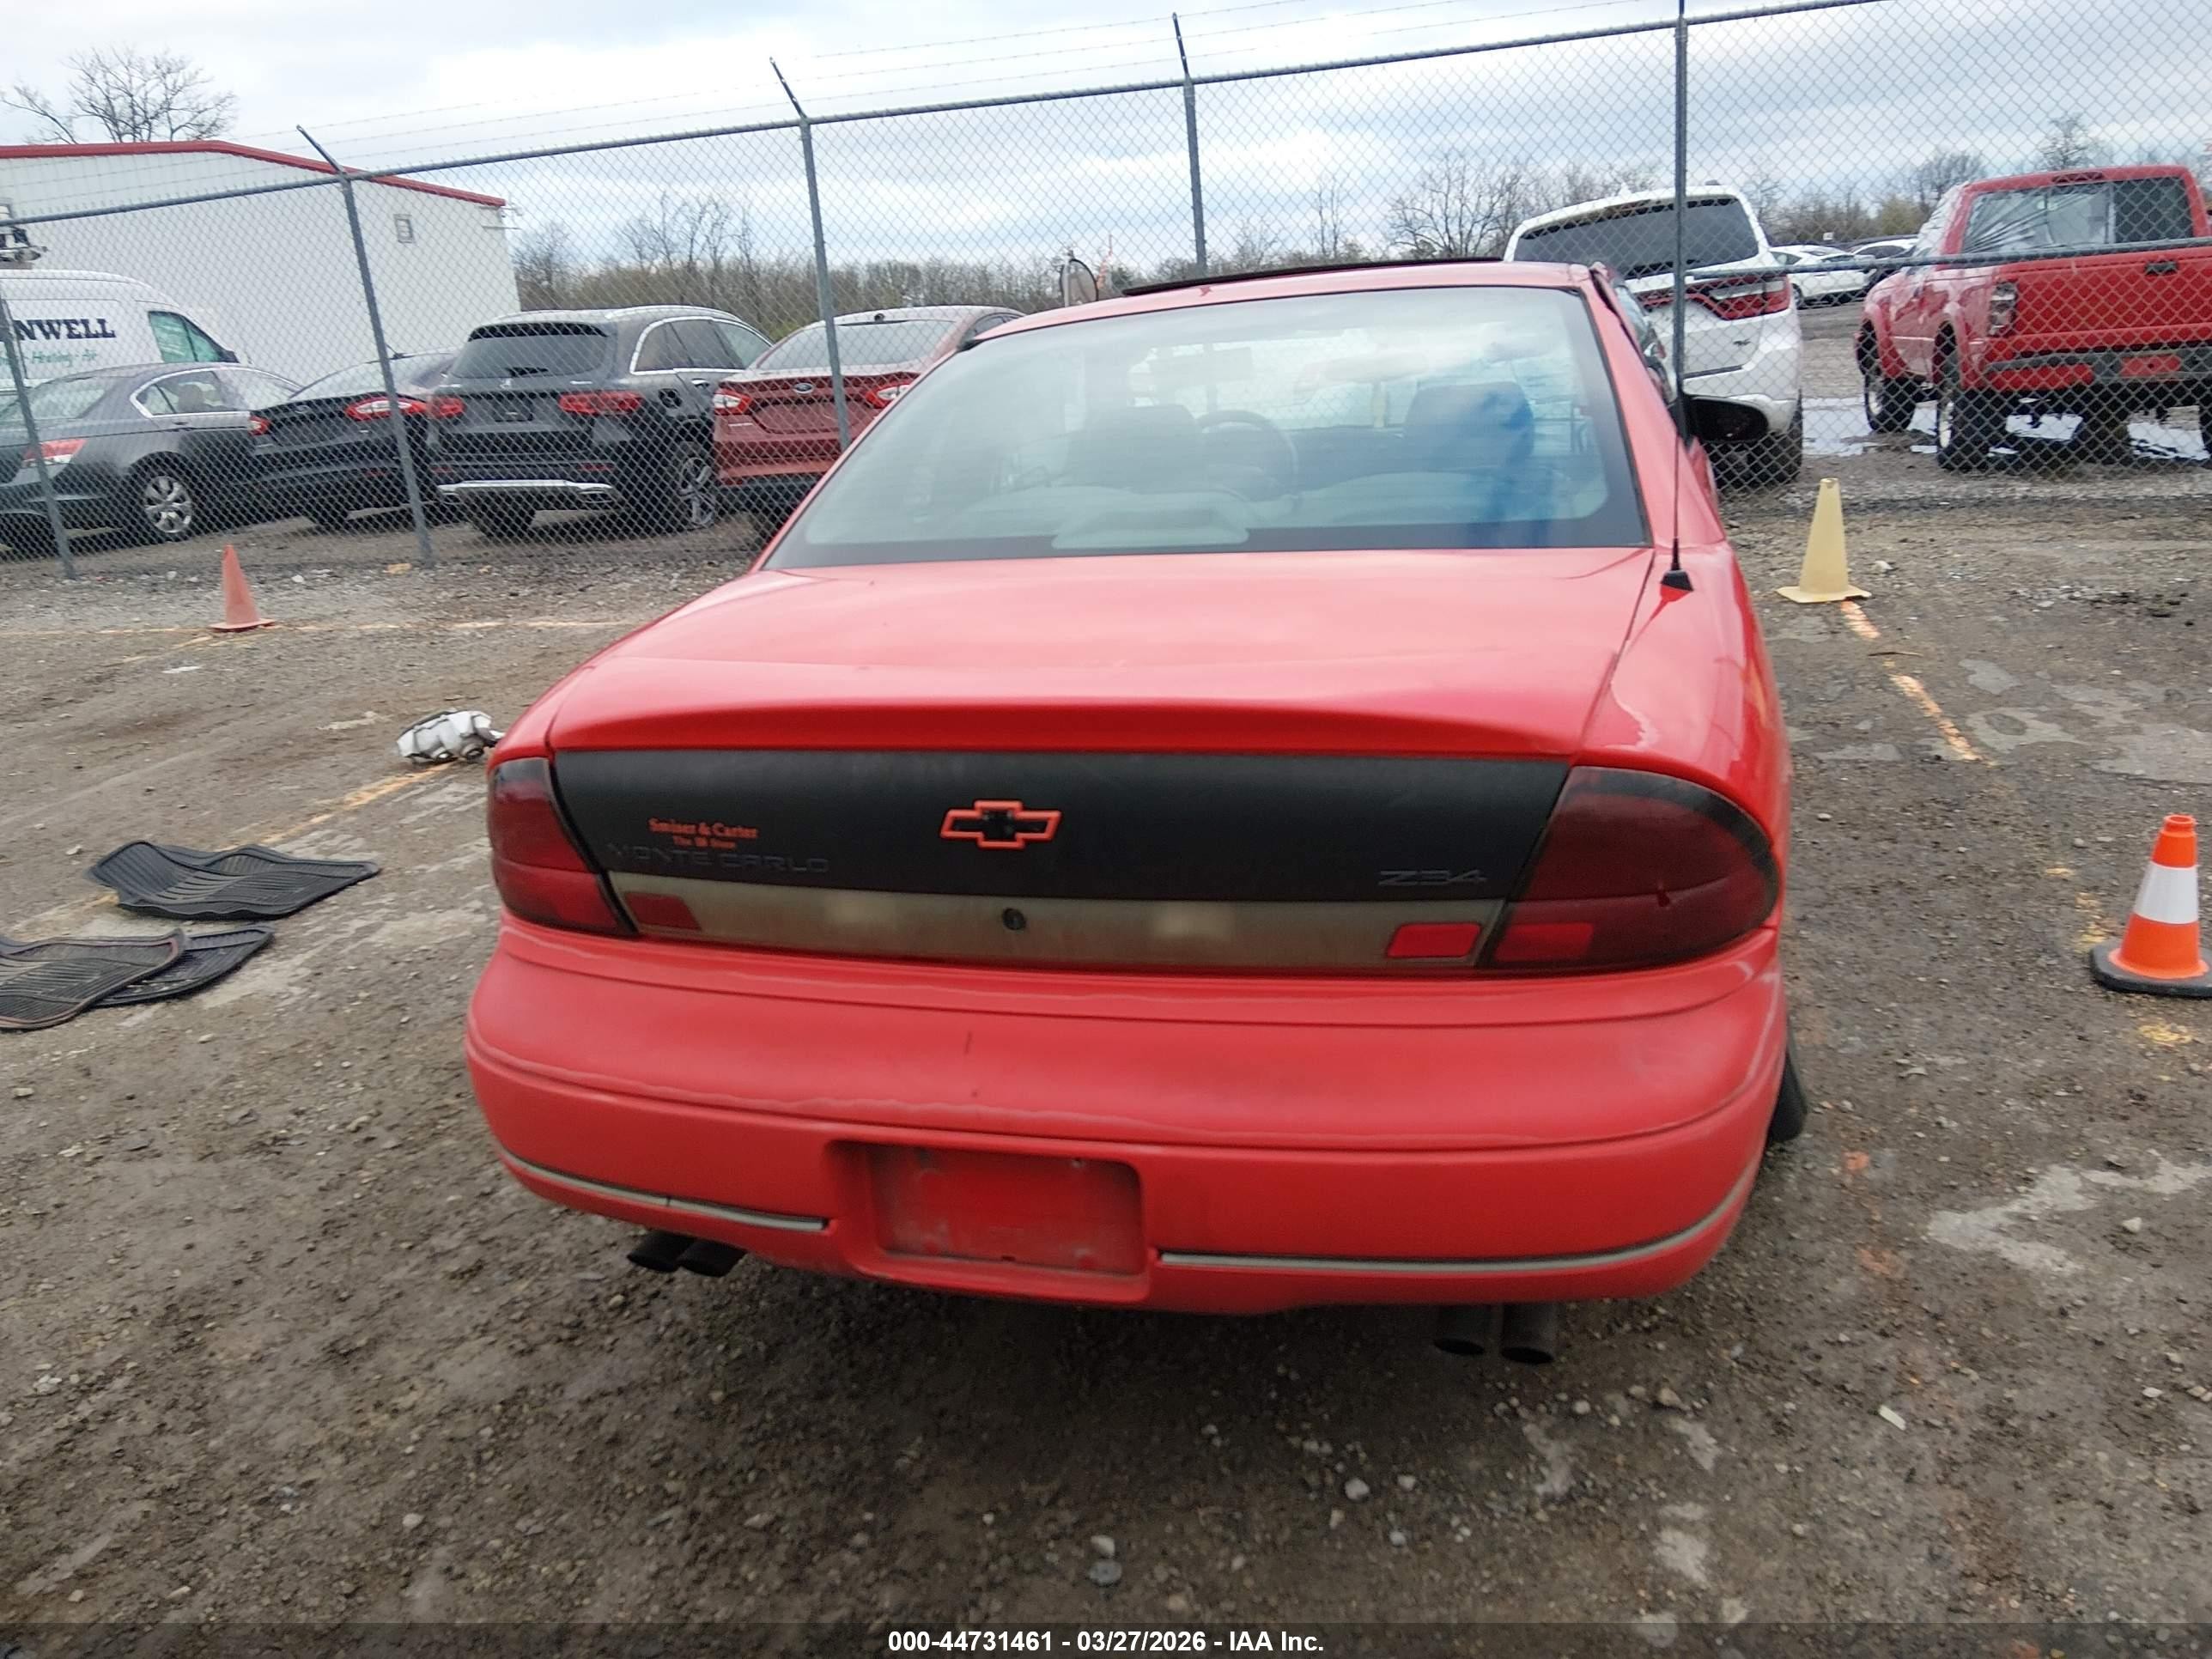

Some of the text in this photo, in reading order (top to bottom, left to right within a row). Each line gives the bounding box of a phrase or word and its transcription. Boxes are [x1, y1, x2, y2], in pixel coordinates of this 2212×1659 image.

[11, 318, 117, 341] NWELL
[606, 842, 713, 865] MONTE
[720, 853, 830, 873] CARLO
[1377, 868, 1489, 887] Z34
